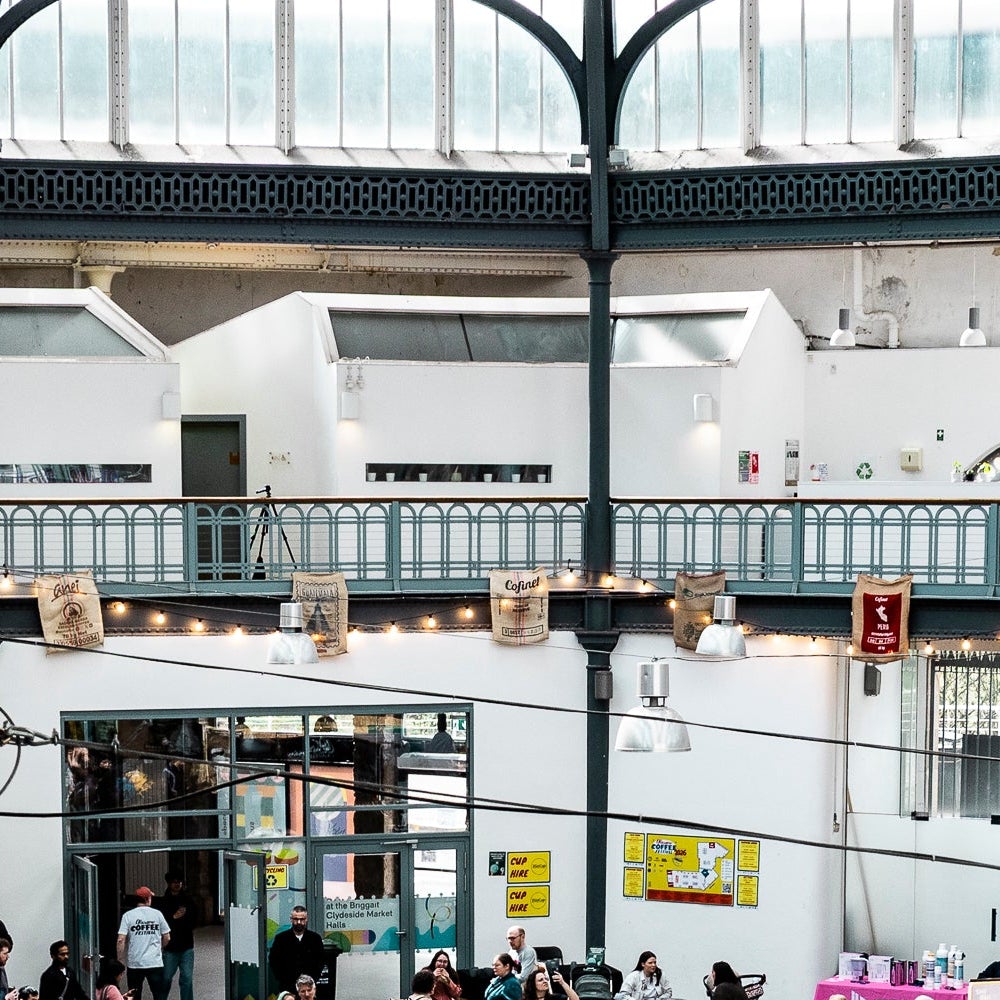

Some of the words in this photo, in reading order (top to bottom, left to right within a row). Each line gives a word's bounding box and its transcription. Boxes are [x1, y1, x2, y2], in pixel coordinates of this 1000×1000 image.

[505, 576, 540, 594] Cofinet
[651, 843, 677, 851] COFFEE
[510, 857, 528, 866] CUP
[510, 869, 529, 878] HIRE
[509, 891, 527, 900] CUP
[335, 902, 348, 910] the
[349, 901, 380, 910] Briggait
[509, 903, 528, 912] HIRE
[326, 911, 365, 920] Clydeside
[366, 910, 393, 918] Market
[130, 924, 160, 932] COFFEE
[326, 921, 346, 929] Halls
